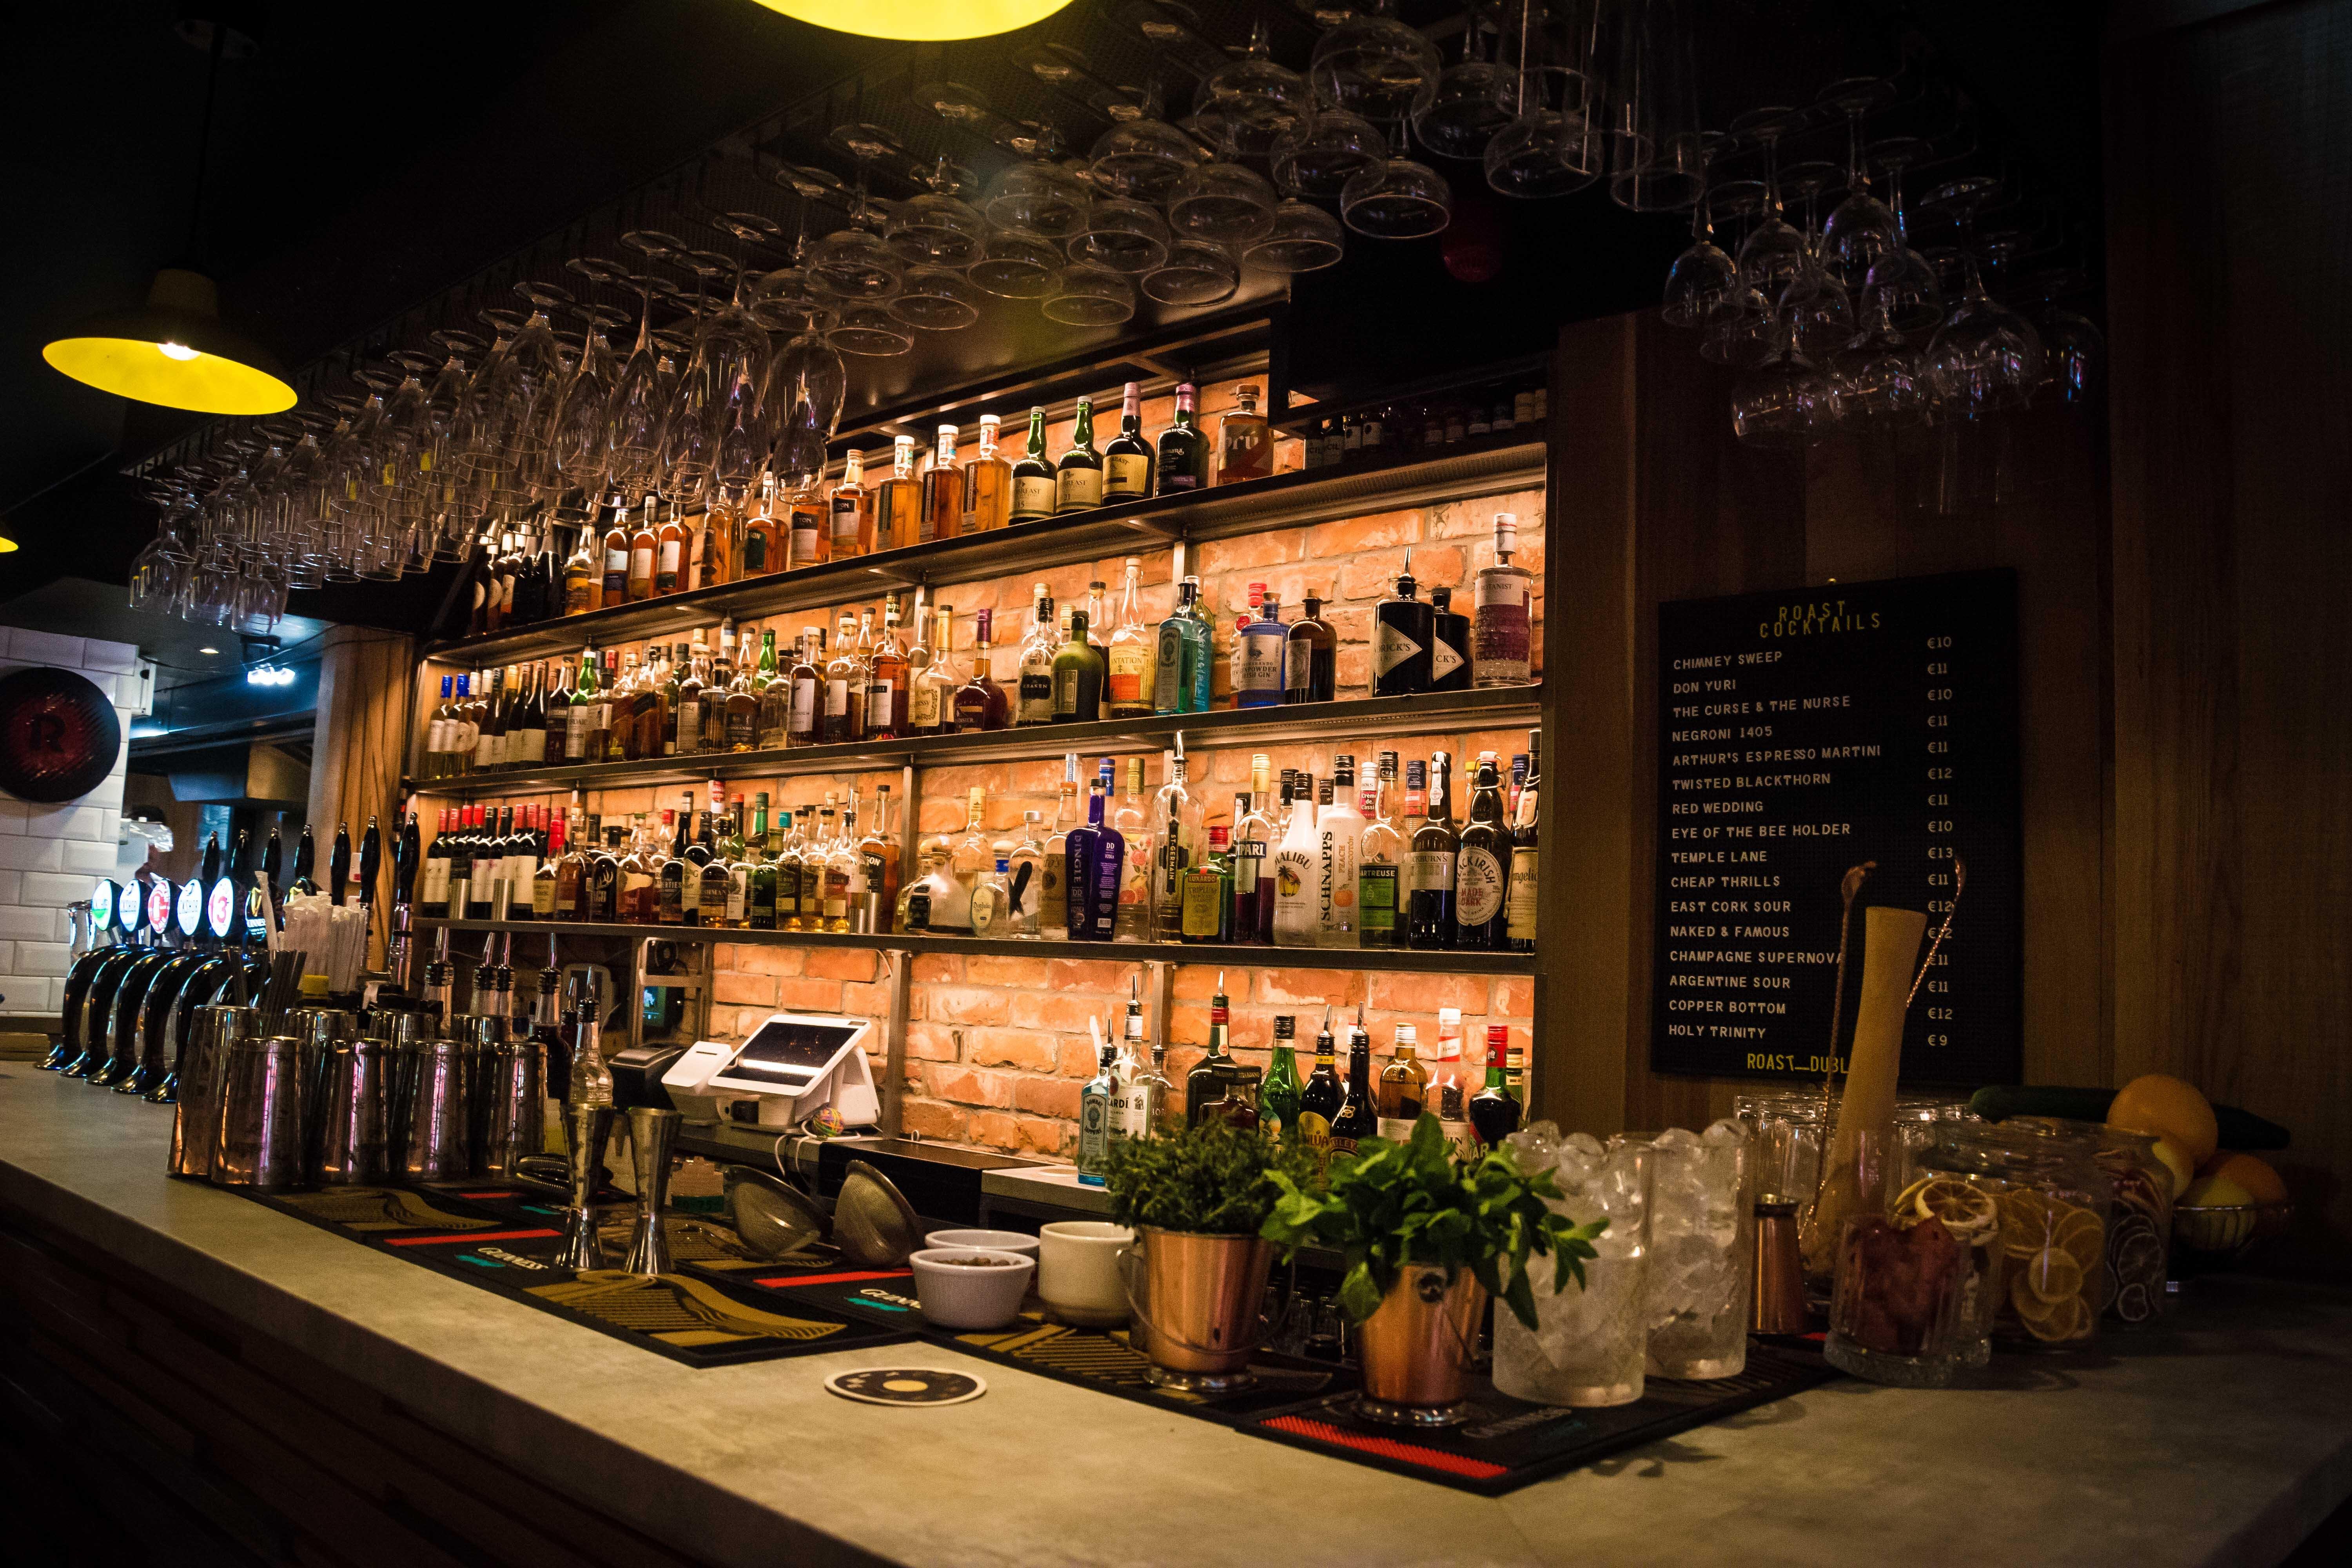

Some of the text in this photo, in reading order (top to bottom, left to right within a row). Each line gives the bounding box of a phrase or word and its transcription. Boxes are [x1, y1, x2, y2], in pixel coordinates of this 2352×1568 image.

[1779, 600, 1846, 622] ROAST
[1760, 613, 1880, 639] COCKTAILS
[1673, 637, 1952, 670] CHIMNEY SWEEP €10
[1673, 664, 1947, 694] DON YURI €11
[1673, 689, 1952, 718] THE CURSE & THE NURSE €10
[31, 714, 64, 751] R
[1672, 715, 1948, 742] NEGRONI 1405 €11
[1673, 741, 1948, 766] ARTHUR'S ESPRESSO MARTINI €11
[1672, 768, 1952, 790] TWISTED BLACKTHORN €12
[1672, 794, 1948, 814] RED WEDDING €11
[1672, 820, 1953, 839] EYE OF THE BEE HOLDER €10
[1074, 835, 1082, 883] DINGLE
[1671, 847, 1953, 863] TEMPLE LANE €13
[1321, 831, 1333, 921] SCHNAPPS
[1475, 858, 1496, 884] IRISH
[1671, 874, 1948, 887] CHEAP THRILLS €11
[1671, 900, 1953, 913] EAST CORK SOUR €12
[1670, 926, 1953, 939] NAKED & FAMOUS €2
[1670, 950, 1751, 963] CHAMPAGNE
[1670, 975, 1948, 993] ARGENTINE SOUR €11
[1669, 1000, 1953, 1020] COPPER BOTTOM €12
[1669, 1024, 1947, 1046] HOLY TRINITY €9
[1747, 1052, 1849, 1074] ROAST_DUBL
